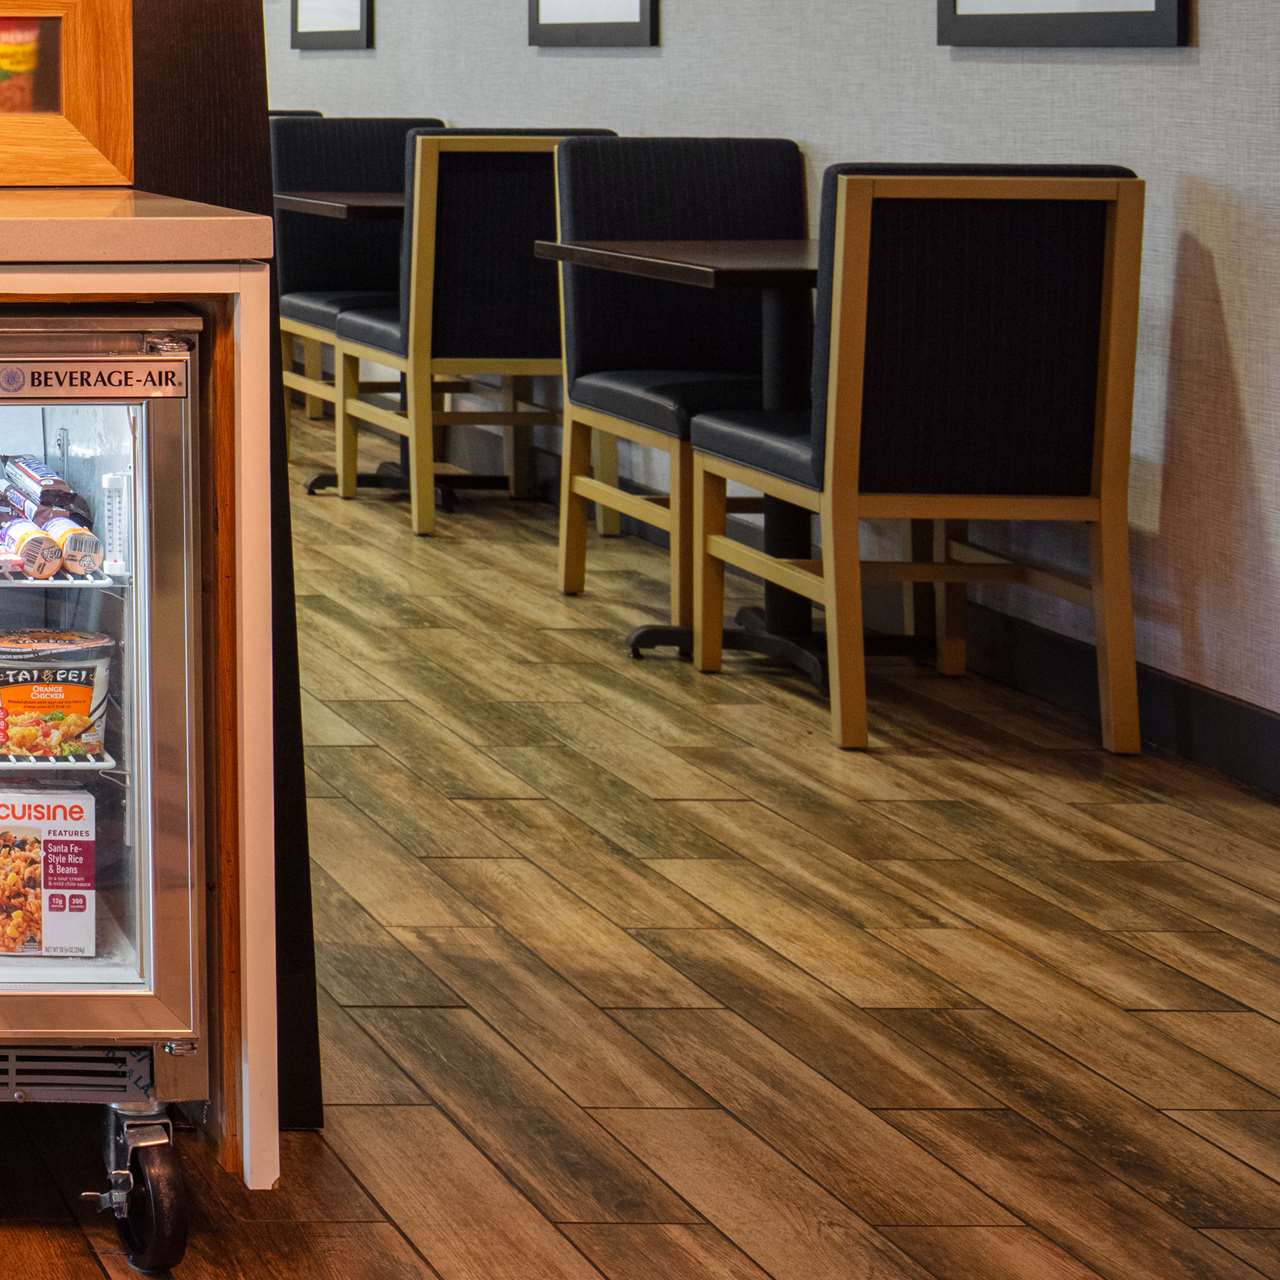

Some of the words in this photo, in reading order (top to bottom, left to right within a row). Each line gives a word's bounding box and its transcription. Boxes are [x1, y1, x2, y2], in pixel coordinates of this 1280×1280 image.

[30, 370, 177, 387] BEVERAGE-AIR
[6, 670, 38, 682] TAI
[56, 670, 87, 681] PEI
[47, 829, 90, 837] FEATURES
[48, 843, 68, 853] Santa
[69, 843, 82, 853] Fe-
[48, 854, 66, 865] Style
[68, 854, 84, 864] Rice
[48, 865, 55, 874] &
[56, 864, 78, 874] Beans
